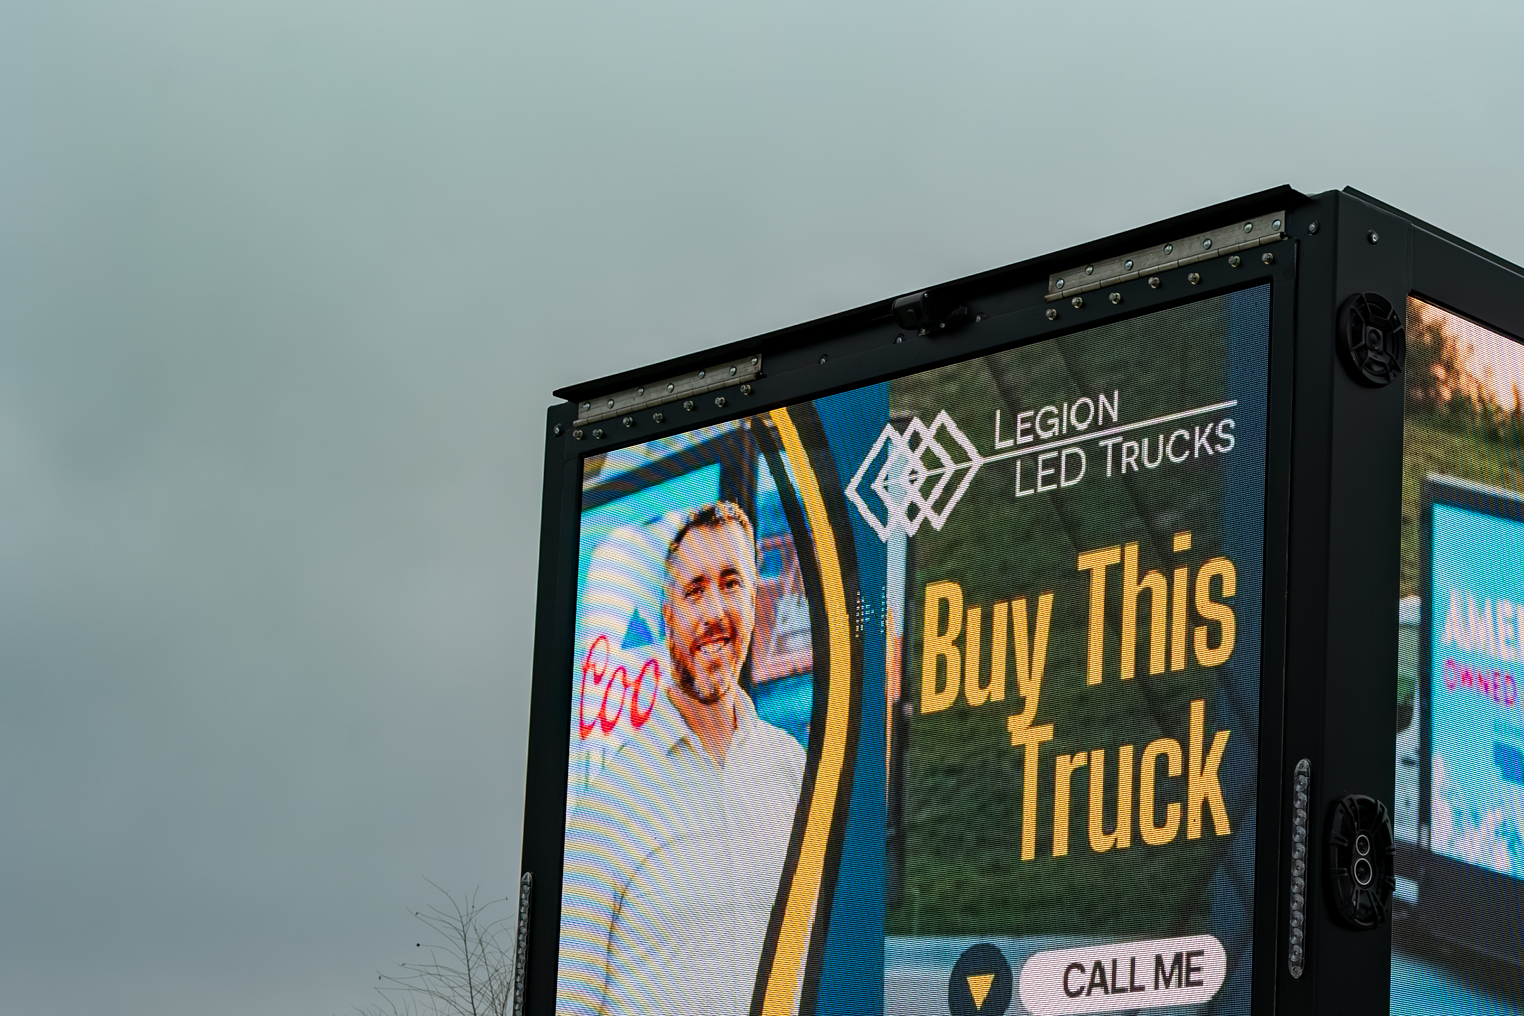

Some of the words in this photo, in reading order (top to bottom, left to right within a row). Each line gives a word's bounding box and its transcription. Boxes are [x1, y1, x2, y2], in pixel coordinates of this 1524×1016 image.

[1014, 445, 1086, 498] LED
[919, 579, 1054, 735] Buy
[1077, 531, 1238, 686] This
[1444, 658, 1518, 707] OWNED
[1010, 700, 1231, 862] Truck
[1062, 956, 1144, 998] CALL
[1152, 950, 1205, 992] ME
